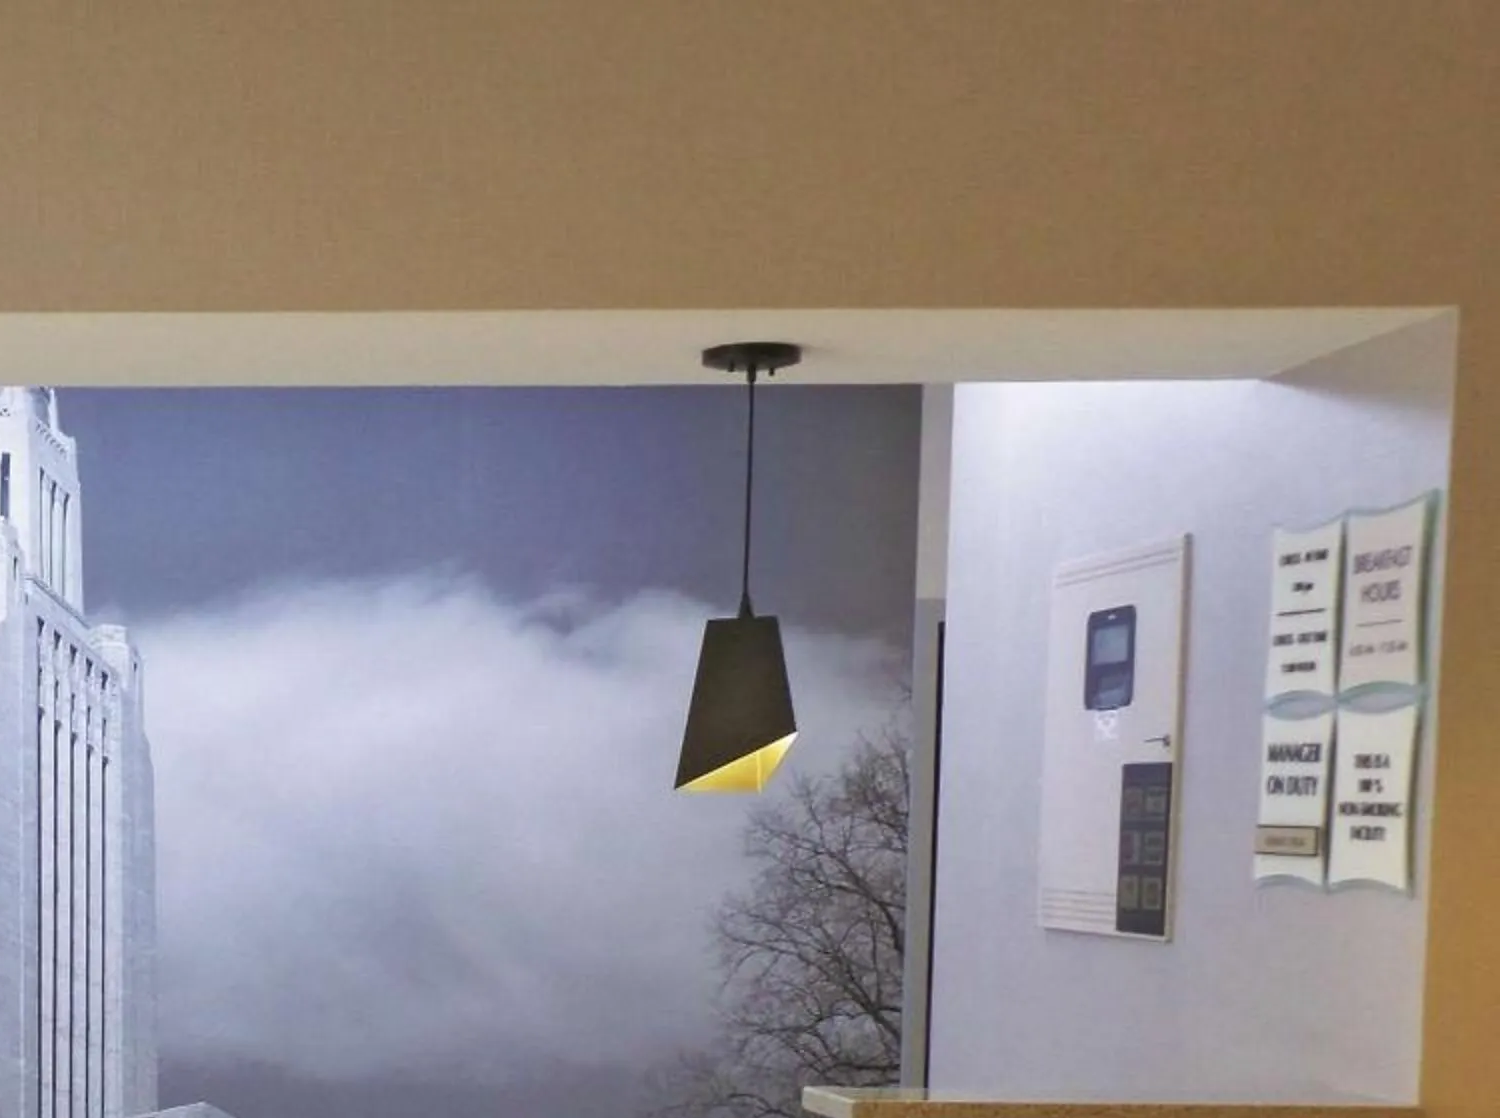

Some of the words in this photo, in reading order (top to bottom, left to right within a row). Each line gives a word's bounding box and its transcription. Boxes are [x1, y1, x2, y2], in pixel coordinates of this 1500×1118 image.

[1361, 579, 1401, 603] HOURS
[1267, 743, 1321, 762] MANAGER
[1267, 776, 1284, 795] ON
[1286, 776, 1317, 796] DUTY
